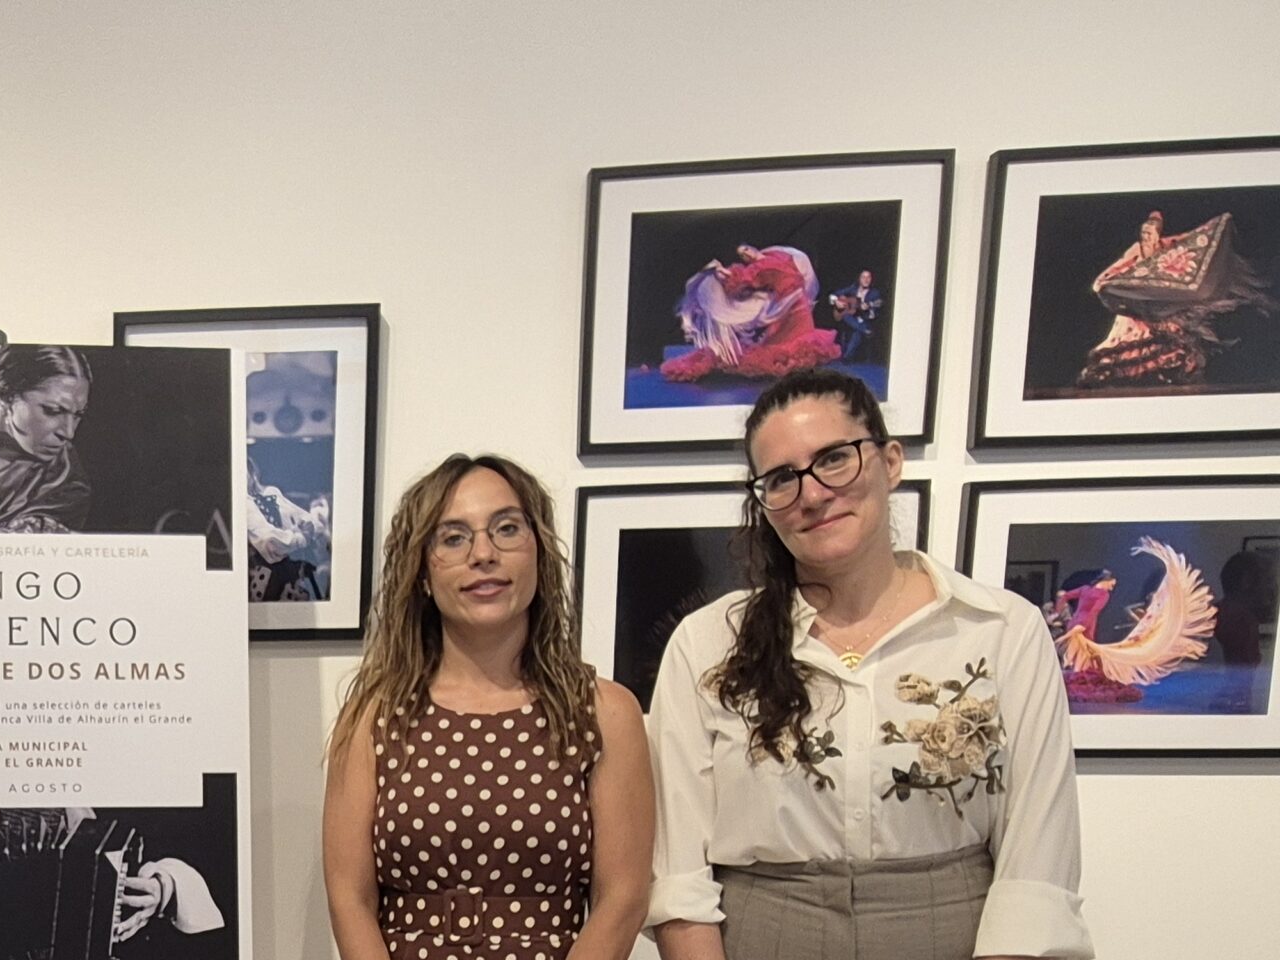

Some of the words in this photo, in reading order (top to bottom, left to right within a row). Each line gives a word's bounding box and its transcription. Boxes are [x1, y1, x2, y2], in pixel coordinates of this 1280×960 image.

[51, 547, 60, 558] Y
[65, 546, 150, 559] CARTELERÍA
[28, 662, 82, 681] DOS
[94, 662, 186, 681] ALMAS
[5, 702, 28, 711] una
[32, 701, 90, 711] selección
[94, 700, 109, 711] de
[113, 700, 162, 711] carteles
[26, 715, 53, 724] Villa
[58, 714, 72, 724] de
[77, 714, 129, 725] Alhaurín
[134, 715, 145, 724] el
[149, 715, 193, 724] Grande
[9, 741, 89, 752] MUNICIPAL
[5, 757, 20, 768] EL
[25, 757, 83, 768] GRANDE
[8, 783, 83, 794] AGOSTO
